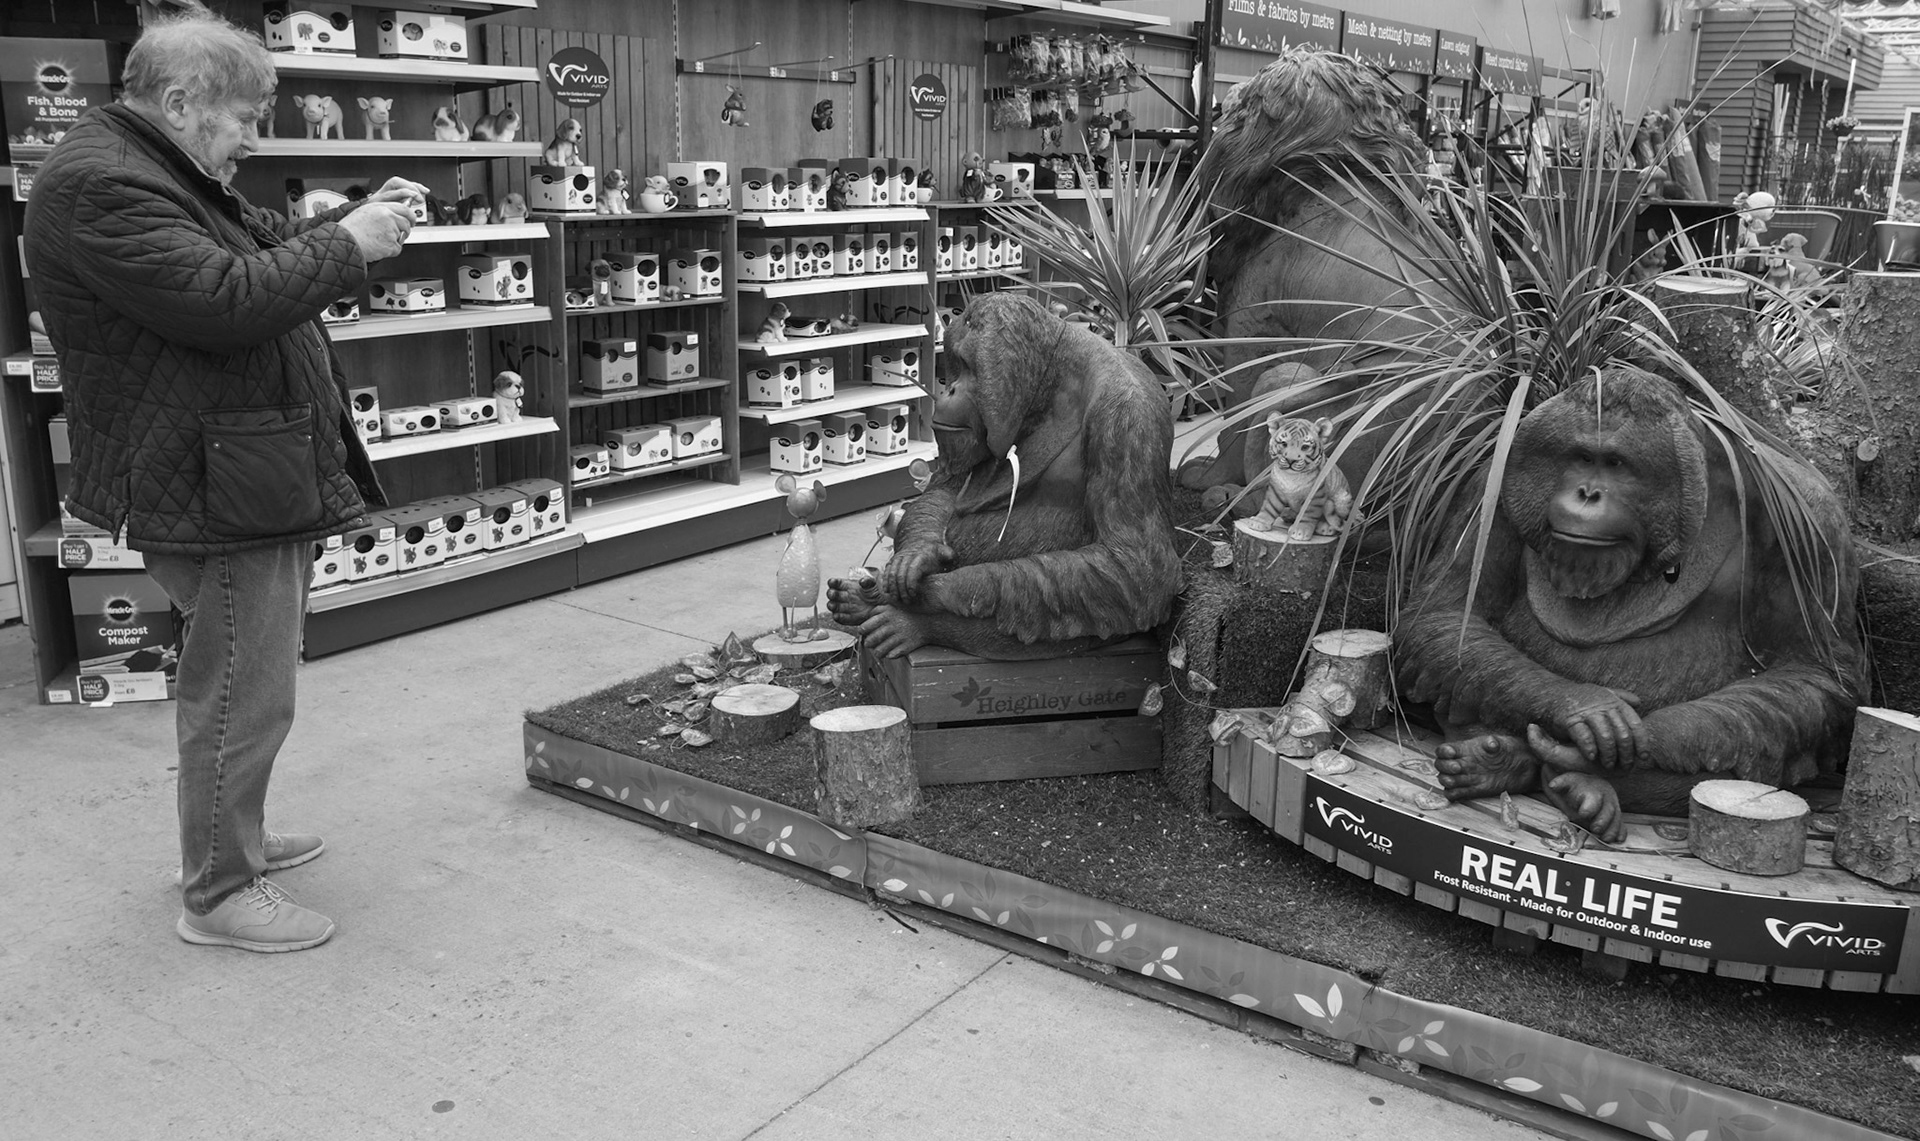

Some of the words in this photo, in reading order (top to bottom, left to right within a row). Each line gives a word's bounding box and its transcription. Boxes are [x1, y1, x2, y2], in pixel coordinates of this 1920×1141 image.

[1228, 0, 1255, 15] Films
[1257, 0, 1267, 17] &
[1268, 2, 1298, 23] fabrics
[1299, 8, 1311, 28] by
[1312, 13, 1335, 30] metre
[1347, 18, 1368, 36] Mesh
[1369, 22, 1377, 38] &
[1378, 25, 1403, 45] netting
[1403, 28, 1412, 47] by
[1413, 32, 1432, 48] metre
[1441, 38, 1455, 52] Lawn
[1455, 41, 1470, 56] edging
[1485, 52, 1498, 67] Weed
[570, 74, 608, 84] VIVID
[27, 96, 53, 107] Fish,
[54, 97, 87, 106] Blood
[923, 94, 946, 102] VIVID
[39, 107, 47, 116] &
[49, 107, 78, 116] Bone
[99, 626, 148, 637] Compost
[108, 636, 141, 645] Maker
[976, 693, 1073, 714] Heighley
[1079, 689, 1127, 707] Gate
[1341, 818, 1393, 848] VIVID
[1367, 842, 1392, 855] ARTS
[1461, 845, 1568, 904] REAL
[1582, 877, 1682, 929] LIFE
[1434, 870, 1460, 887] Frost
[1462, 880, 1511, 903] Resistant
[1520, 897, 1554, 914] Made
[1556, 906, 1574, 919] for
[1576, 911, 1627, 932] Outdoor
[1630, 924, 1640, 936] &
[1644, 927, 1686, 945] Indoor
[1689, 938, 1712, 949] use
[1806, 934, 1883, 949] VIVID
[1846, 948, 1880, 956] ARTS
